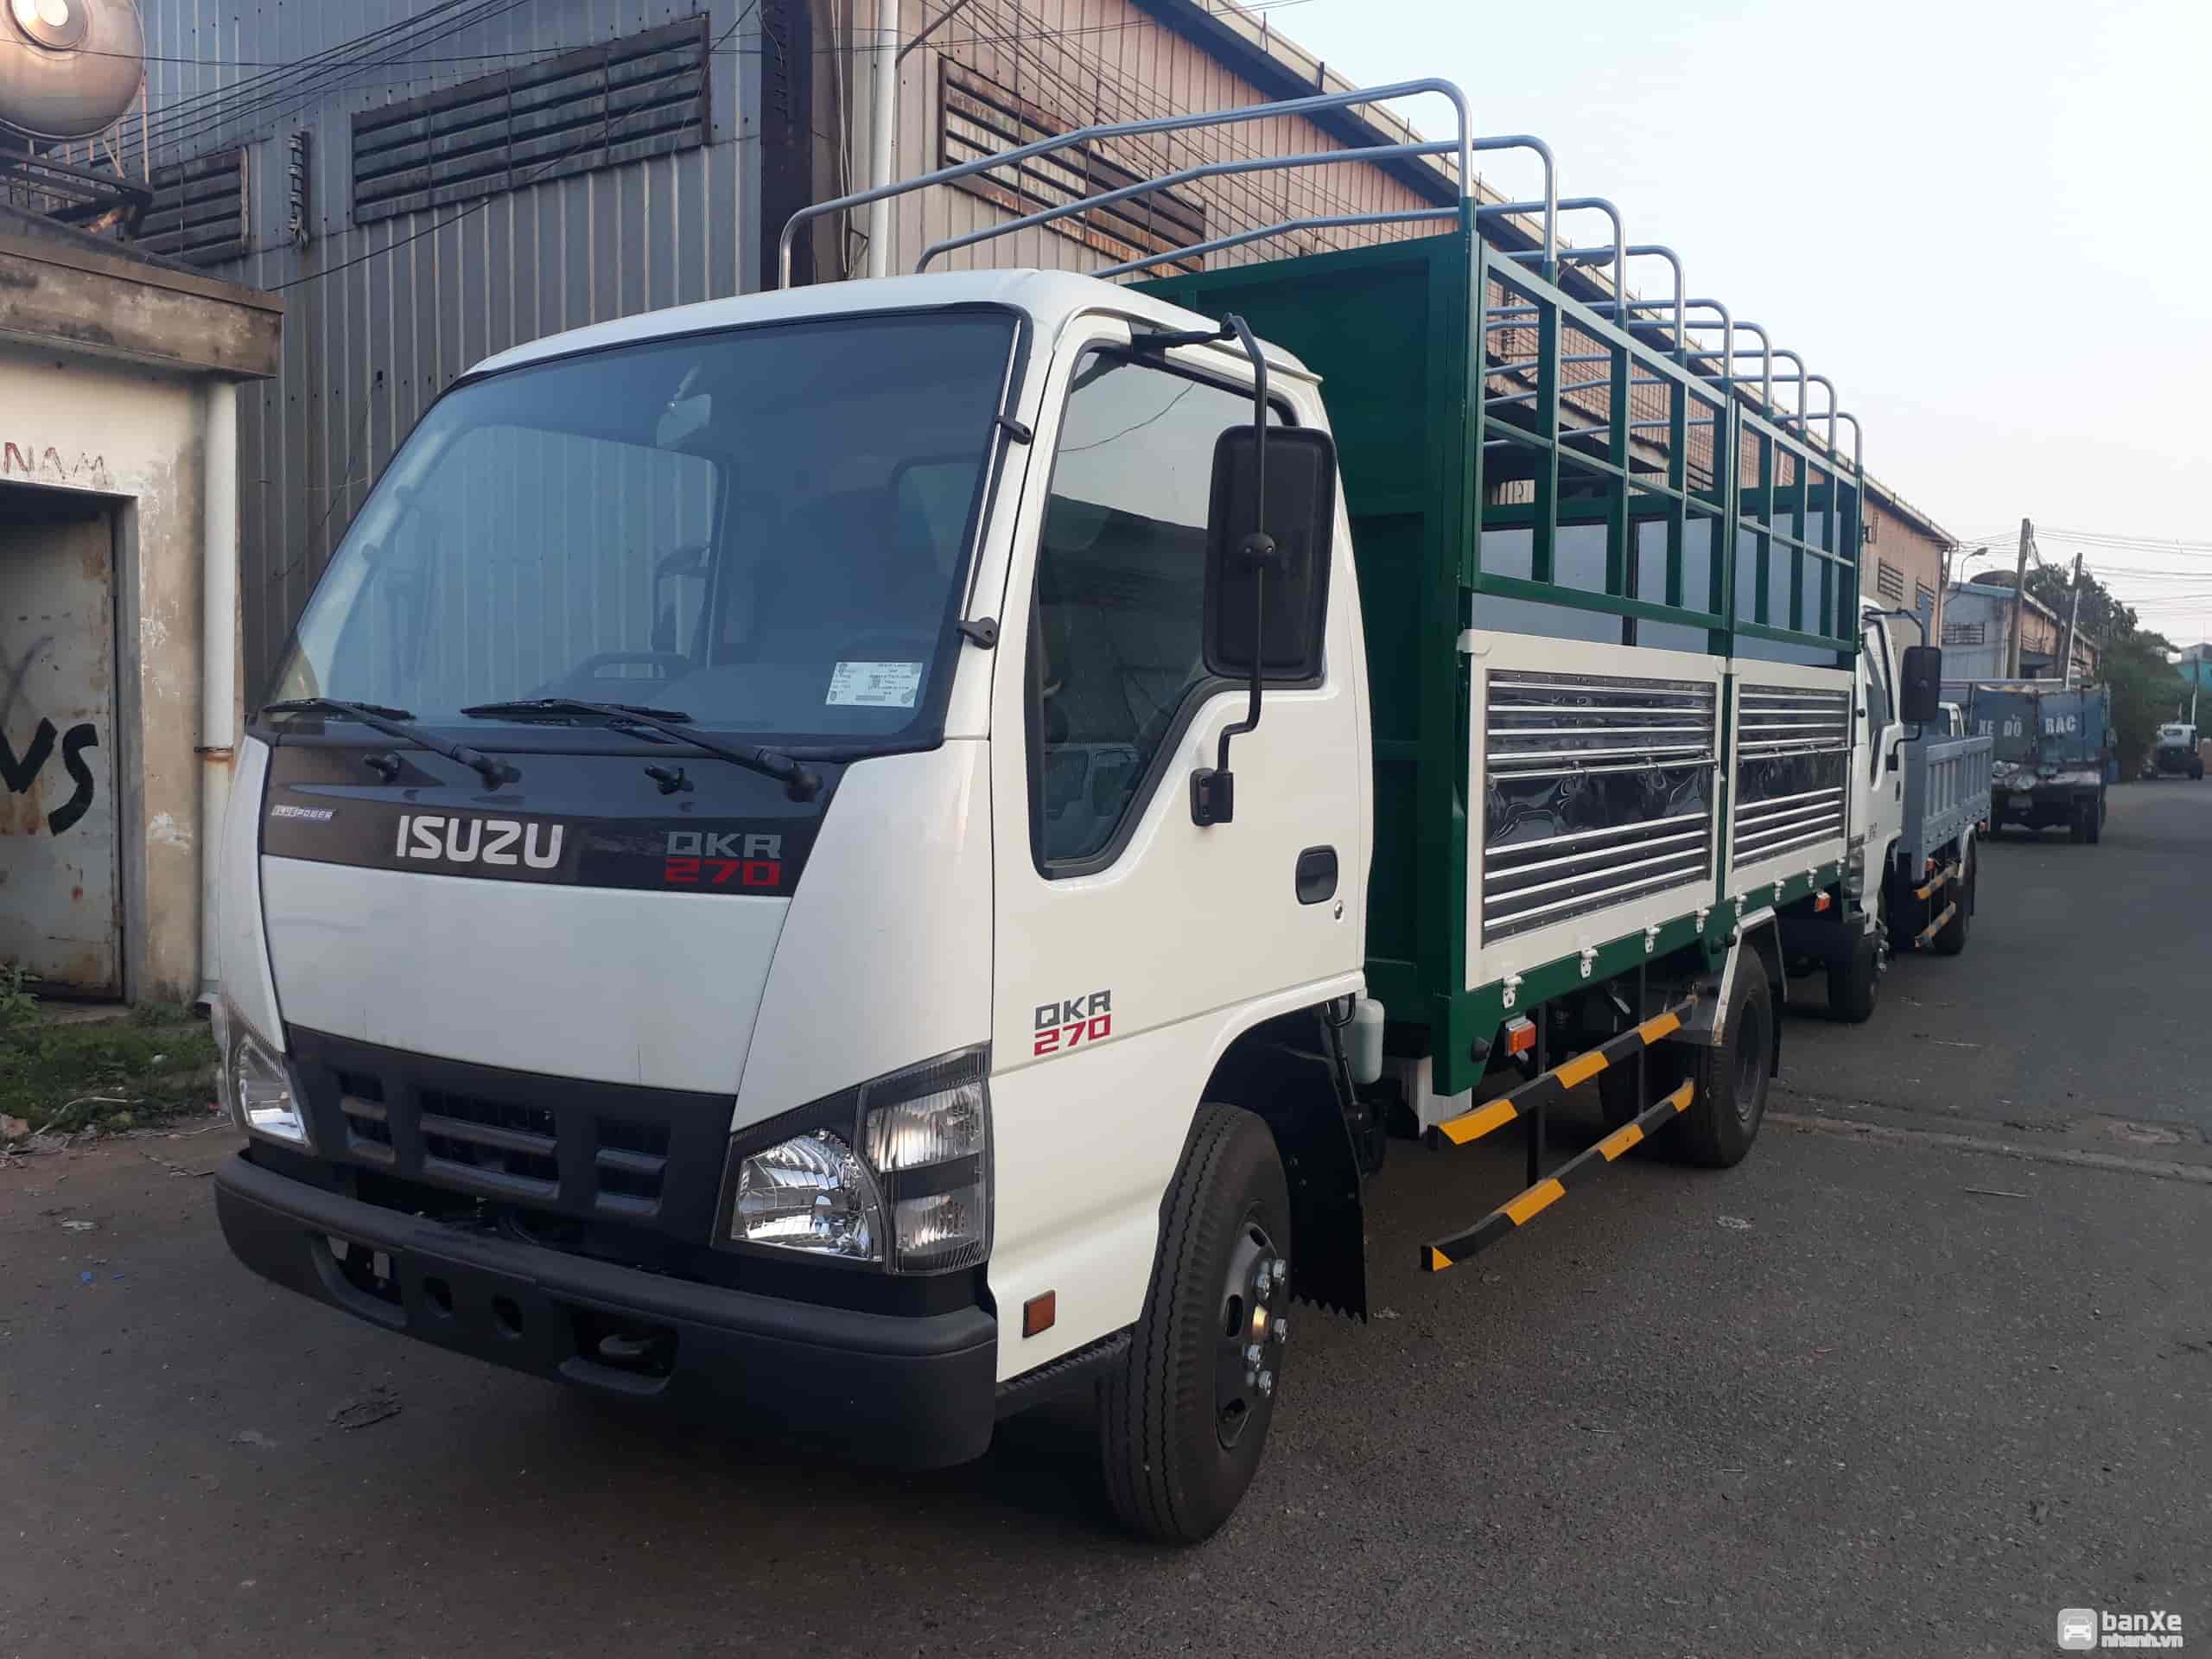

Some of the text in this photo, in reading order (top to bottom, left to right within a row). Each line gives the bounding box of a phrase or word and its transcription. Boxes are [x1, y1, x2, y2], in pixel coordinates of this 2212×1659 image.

[3, 442, 108, 486] NAM
[1979, 719, 1994, 735] XE
[396, 815, 564, 869] ISUZU
[666, 831, 782, 859] QKR
[664, 856, 782, 886] 270
[1034, 988, 1111, 1031] QKR
[1033, 1014, 1111, 1057] 270
